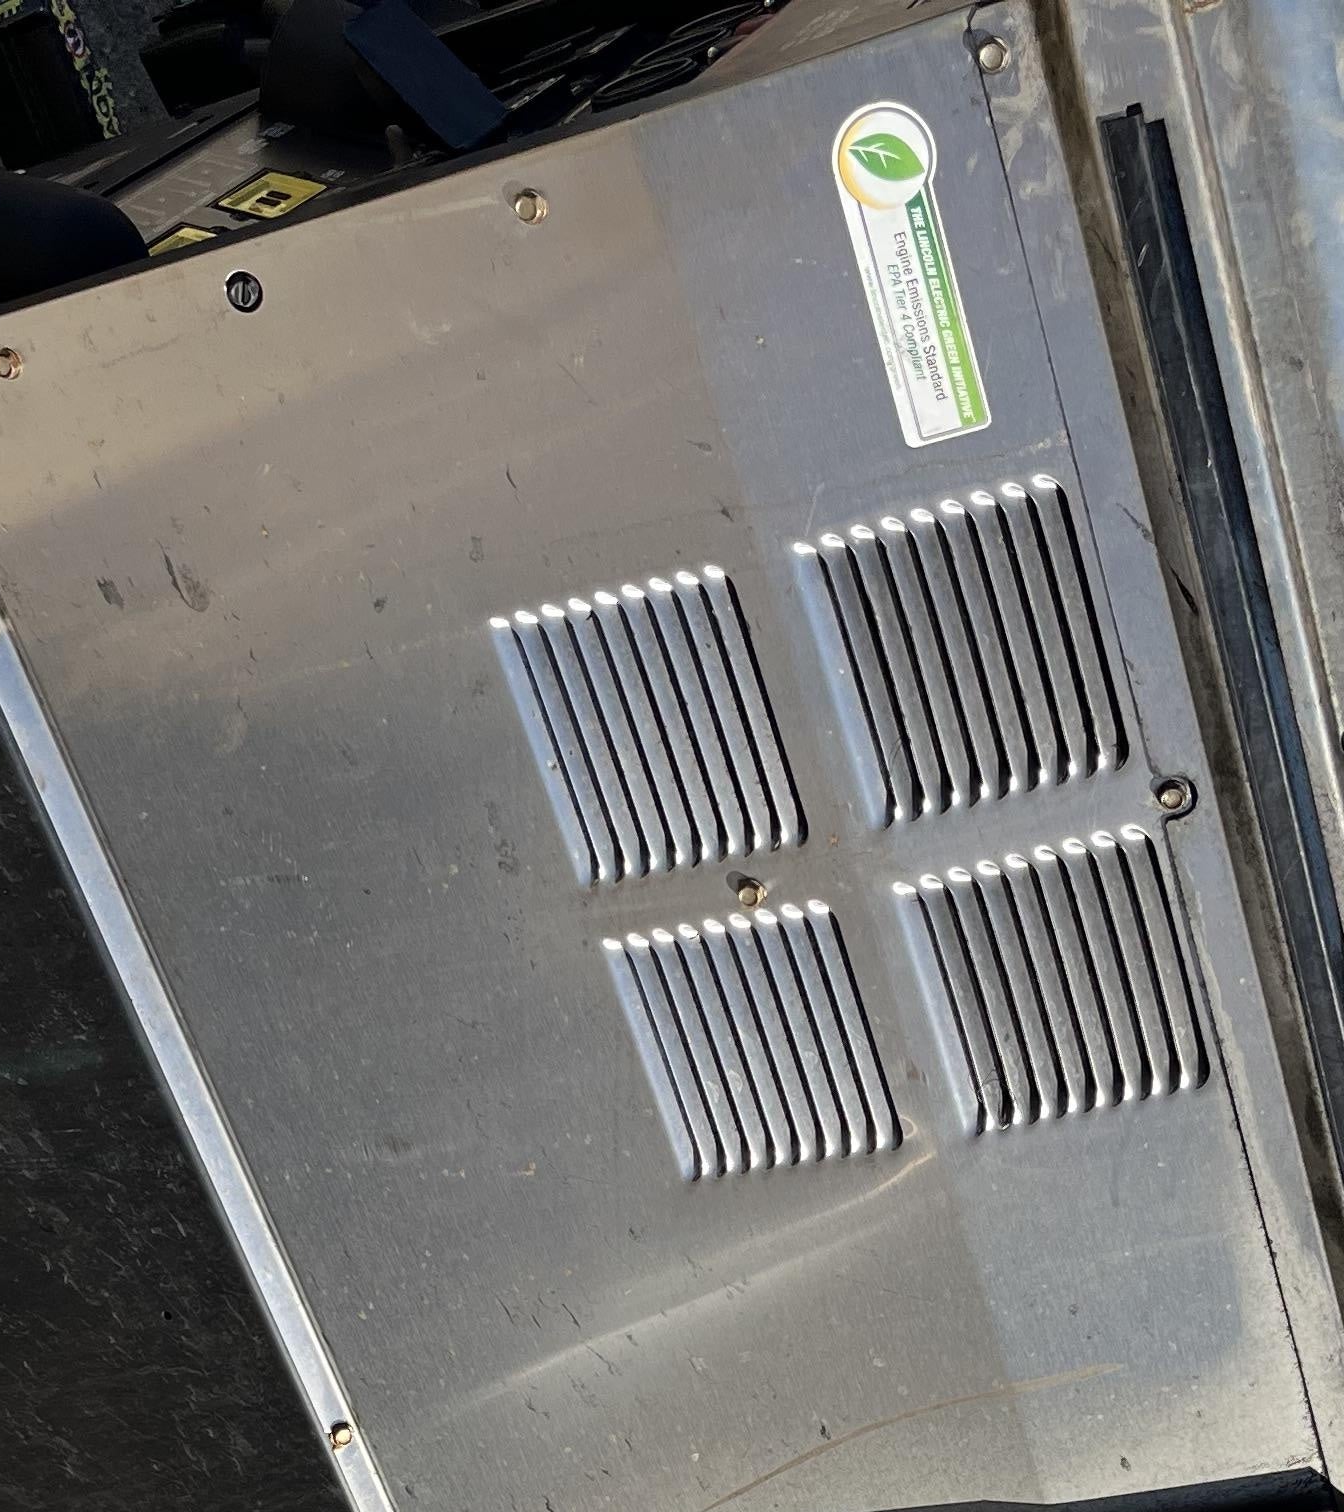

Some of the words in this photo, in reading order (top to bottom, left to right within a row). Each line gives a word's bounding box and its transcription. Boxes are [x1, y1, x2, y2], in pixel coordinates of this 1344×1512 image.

[909, 206, 925, 229] THE
[914, 228, 938, 276] LINCOLN
[886, 262, 902, 286] EPA
[891, 231, 916, 277] Engine
[904, 277, 933, 343] Emissions
[922, 343, 949, 401] Standard
[892, 287, 908, 310] Tier
[899, 312, 911, 322] 4
[927, 276, 951, 327] ELECTRIC
[899, 322, 928, 382] Compliant
[941, 327, 960, 364] GREEN
